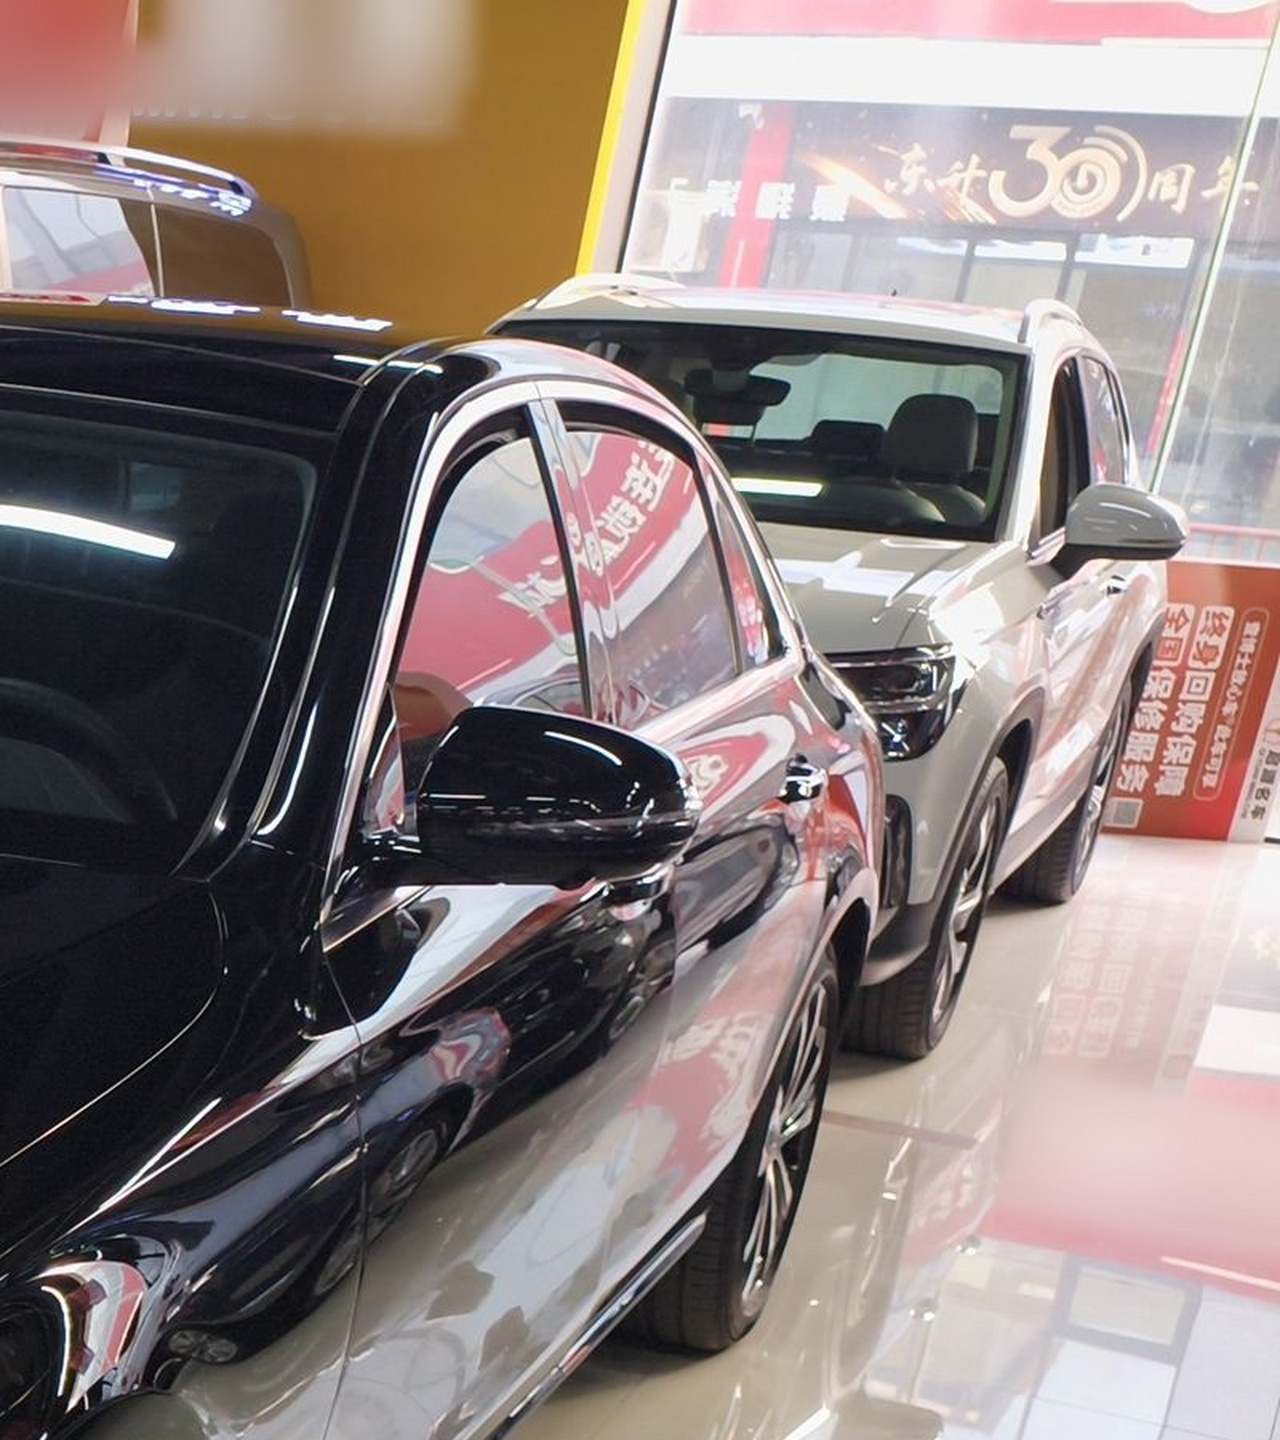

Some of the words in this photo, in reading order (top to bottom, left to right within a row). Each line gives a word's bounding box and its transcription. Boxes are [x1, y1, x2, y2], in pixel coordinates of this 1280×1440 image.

[1155, 608, 1233, 797] 终身回购保障
